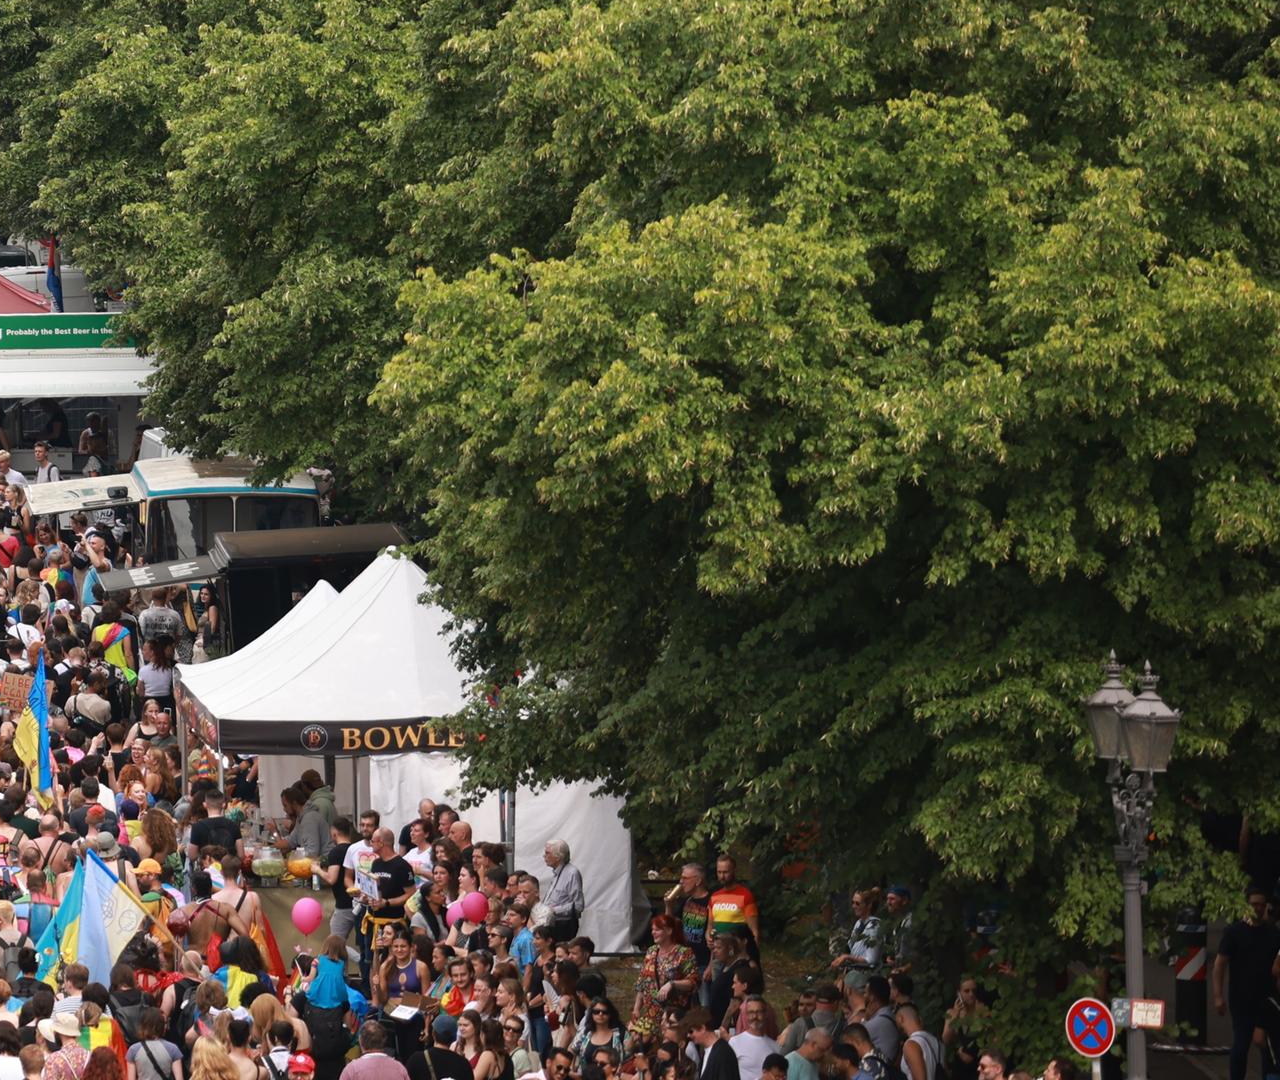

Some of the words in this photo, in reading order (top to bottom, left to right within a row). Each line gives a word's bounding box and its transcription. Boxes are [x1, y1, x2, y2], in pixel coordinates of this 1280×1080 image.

[6, 328, 40, 337] Probably
[54, 327, 71, 335] Best
[72, 327, 90, 335] Beer
[91, 327, 99, 335] in
[340, 723, 465, 751] BOWLE
